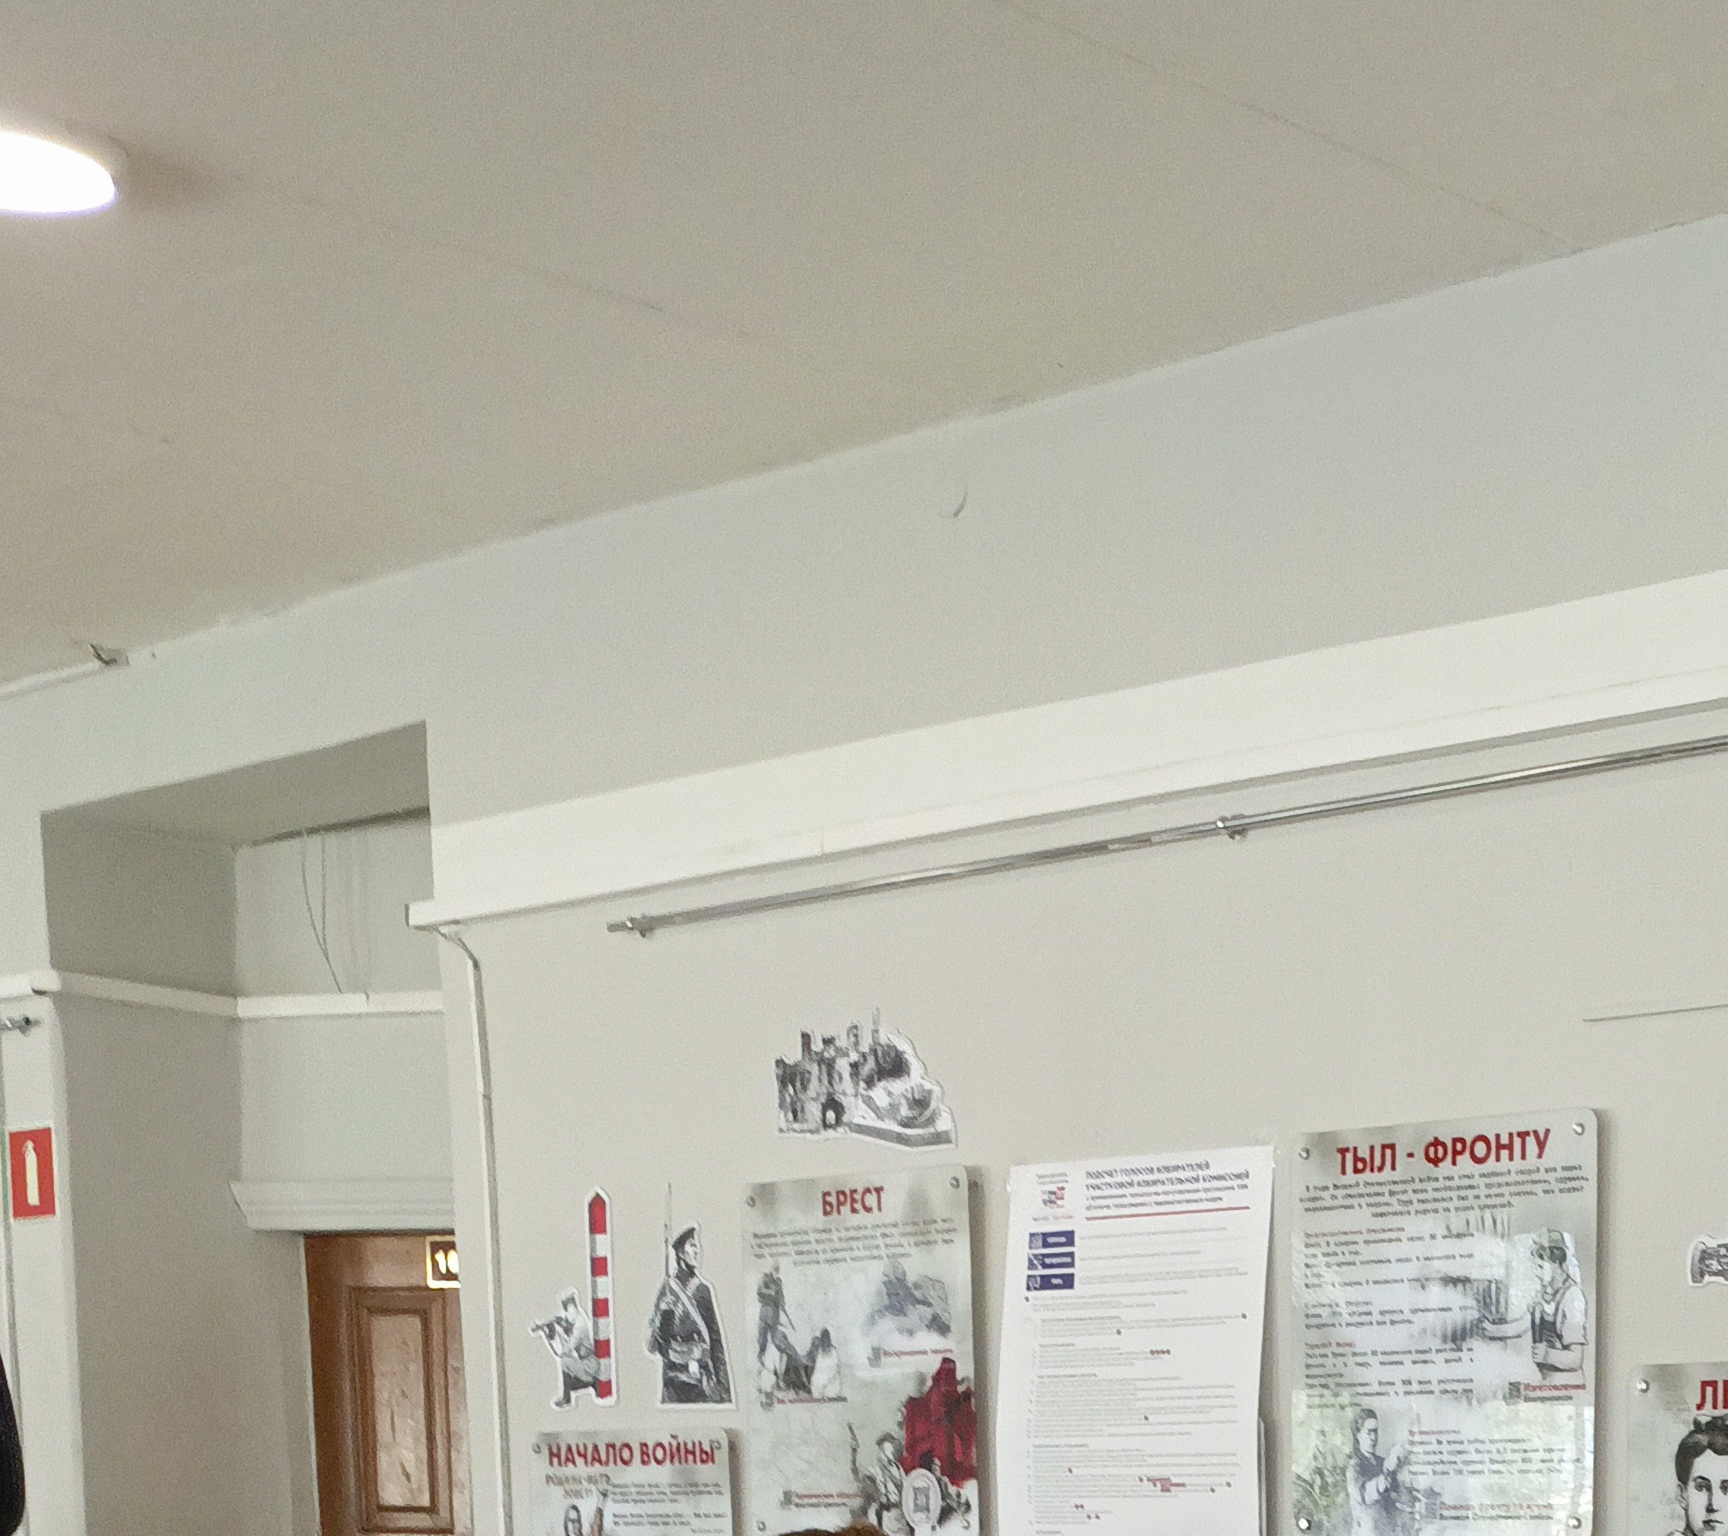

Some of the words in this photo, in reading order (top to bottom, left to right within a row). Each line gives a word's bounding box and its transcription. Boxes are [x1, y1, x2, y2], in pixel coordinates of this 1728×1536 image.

[1337, 1144, 1397, 1176] ТЫЛ
[1424, 1128, 1551, 1169] ФРОНТУ
[821, 1185, 885, 1217] БРЕСТ
[547, 1441, 634, 1468] НАЧАЛО
[639, 1433, 717, 1466] ВОЙНЫ
